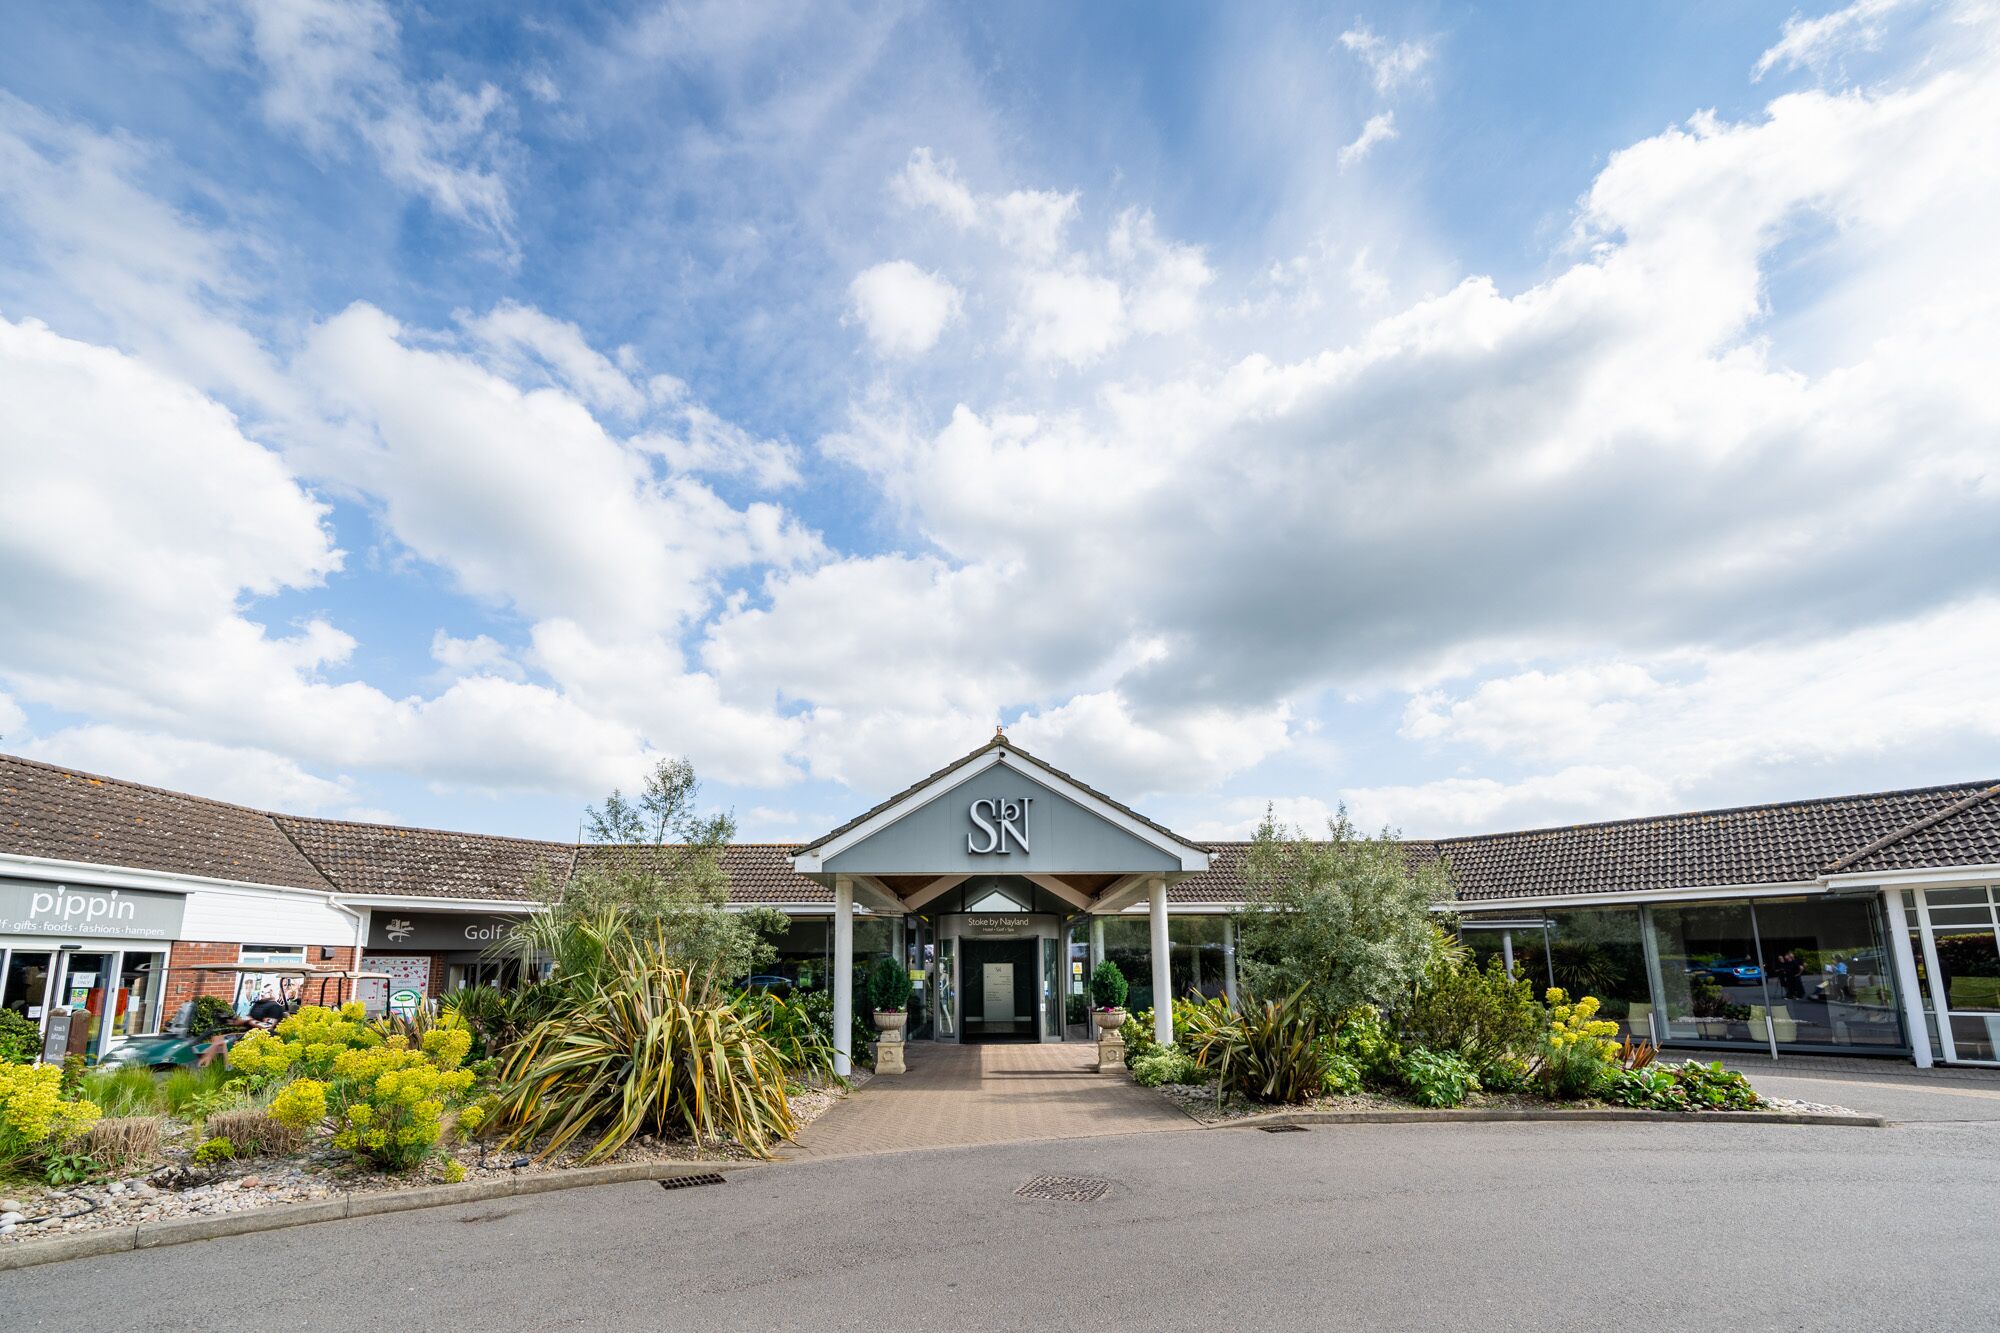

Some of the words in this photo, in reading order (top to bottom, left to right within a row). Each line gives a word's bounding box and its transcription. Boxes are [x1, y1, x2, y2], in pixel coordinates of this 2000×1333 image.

[29, 885, 135, 922] pippin
[13, 919, 37, 932] gifts
[43, 921, 73, 932] foods
[79, 922, 121, 935] fashions
[124, 925, 165, 937] hampers
[968, 917, 989, 926] Stoke
[989, 917, 999, 928] by
[1000, 917, 1029, 928] Nayland
[464, 924, 504, 940] Golf
